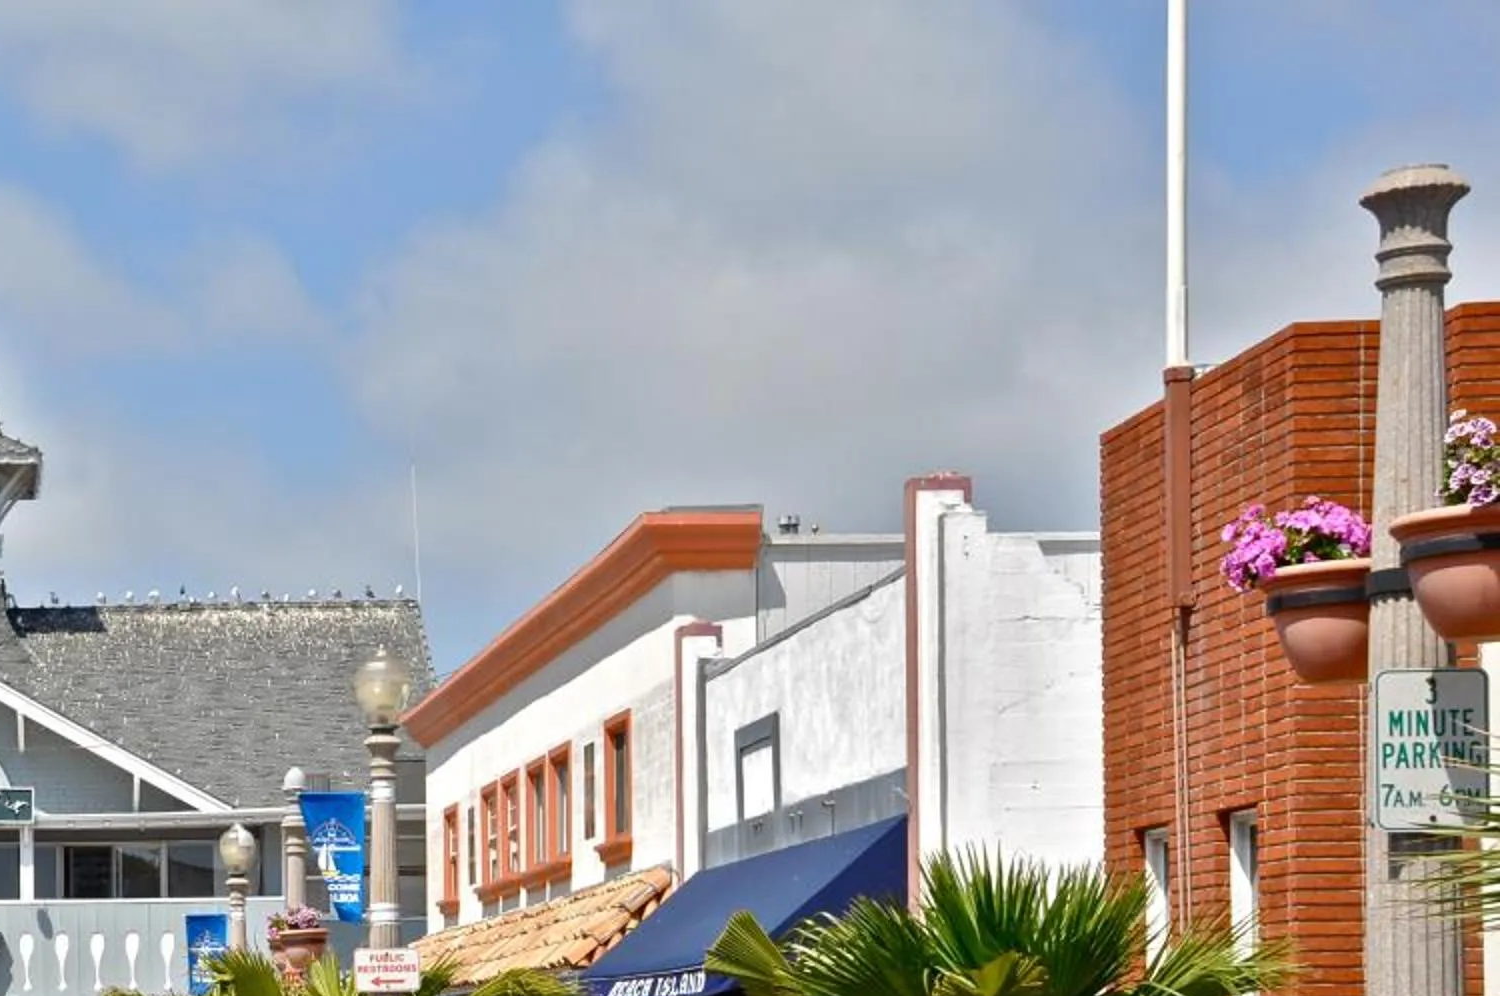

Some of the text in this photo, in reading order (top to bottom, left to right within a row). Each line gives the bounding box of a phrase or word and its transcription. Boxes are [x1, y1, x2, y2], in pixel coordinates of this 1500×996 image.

[1426, 676, 1437, 705] 3
[1389, 709, 1475, 737] MINUTE
[1382, 740, 1484, 769] PARKING
[357, 963, 417, 973] RESTROOMS
[369, 953, 405, 963] PUBLIC
[654, 970, 706, 996] ISLAND
